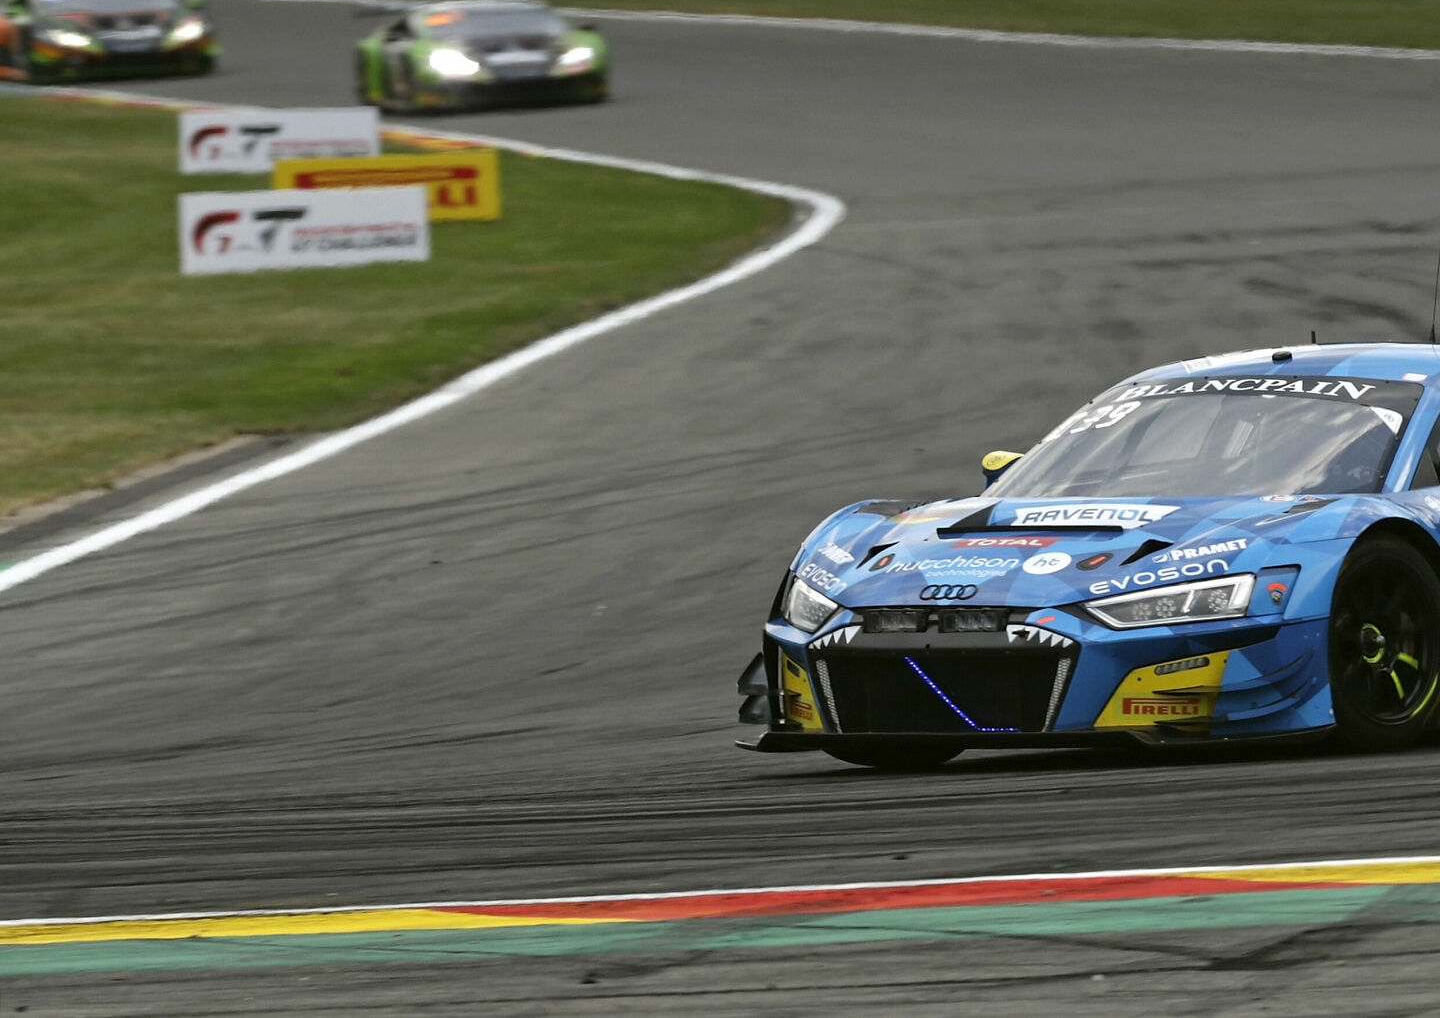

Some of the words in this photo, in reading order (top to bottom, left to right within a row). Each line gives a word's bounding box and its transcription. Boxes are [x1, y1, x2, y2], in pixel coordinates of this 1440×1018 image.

[1116, 378, 1376, 403] BLANCPAIN
[1022, 507, 1157, 525] RAVENOL
[967, 538, 1044, 547] TOTAL
[1171, 538, 1248, 561] PRAMET
[886, 555, 1020, 574] hutchison
[1122, 697, 1200, 715] PIRELLI
